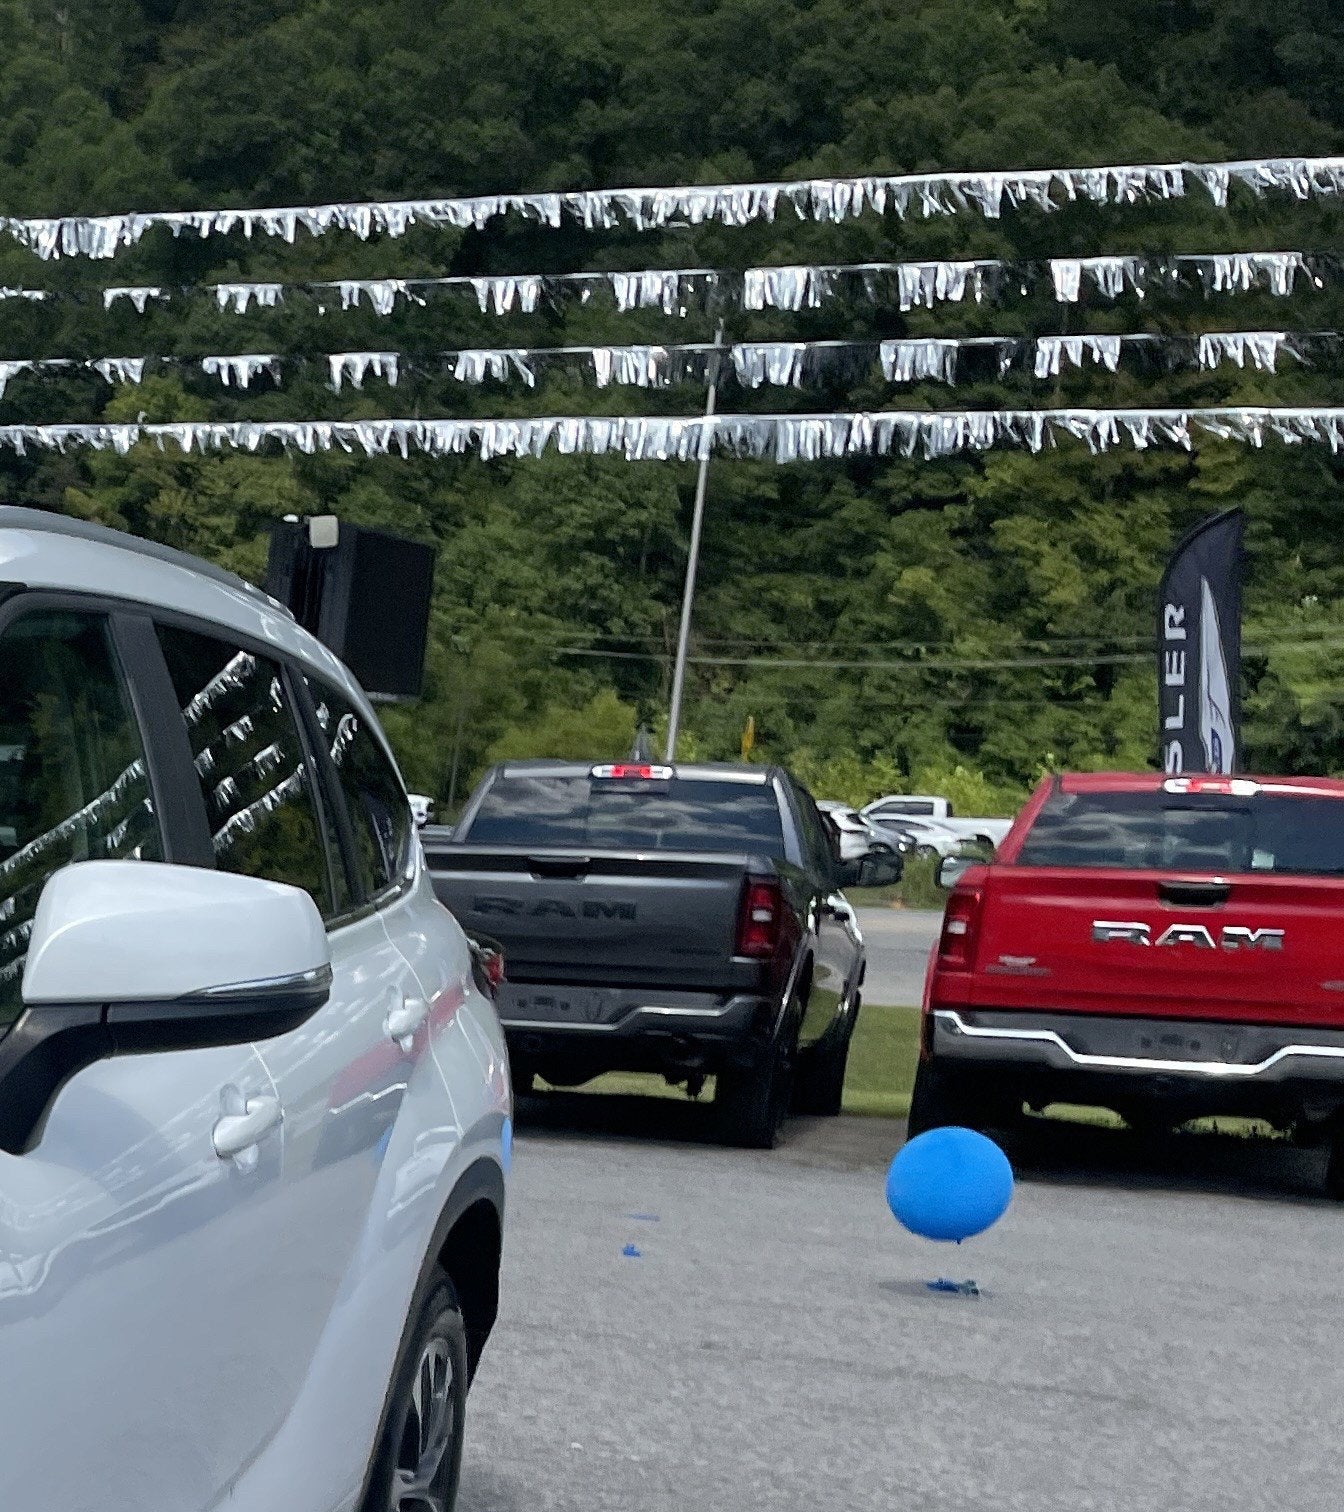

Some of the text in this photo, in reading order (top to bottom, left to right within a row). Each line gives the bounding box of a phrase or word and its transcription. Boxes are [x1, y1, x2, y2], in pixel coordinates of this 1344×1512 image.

[1164, 603, 1187, 776] SLER
[473, 897, 637, 921] RAM
[1091, 919, 1286, 951] RAM
